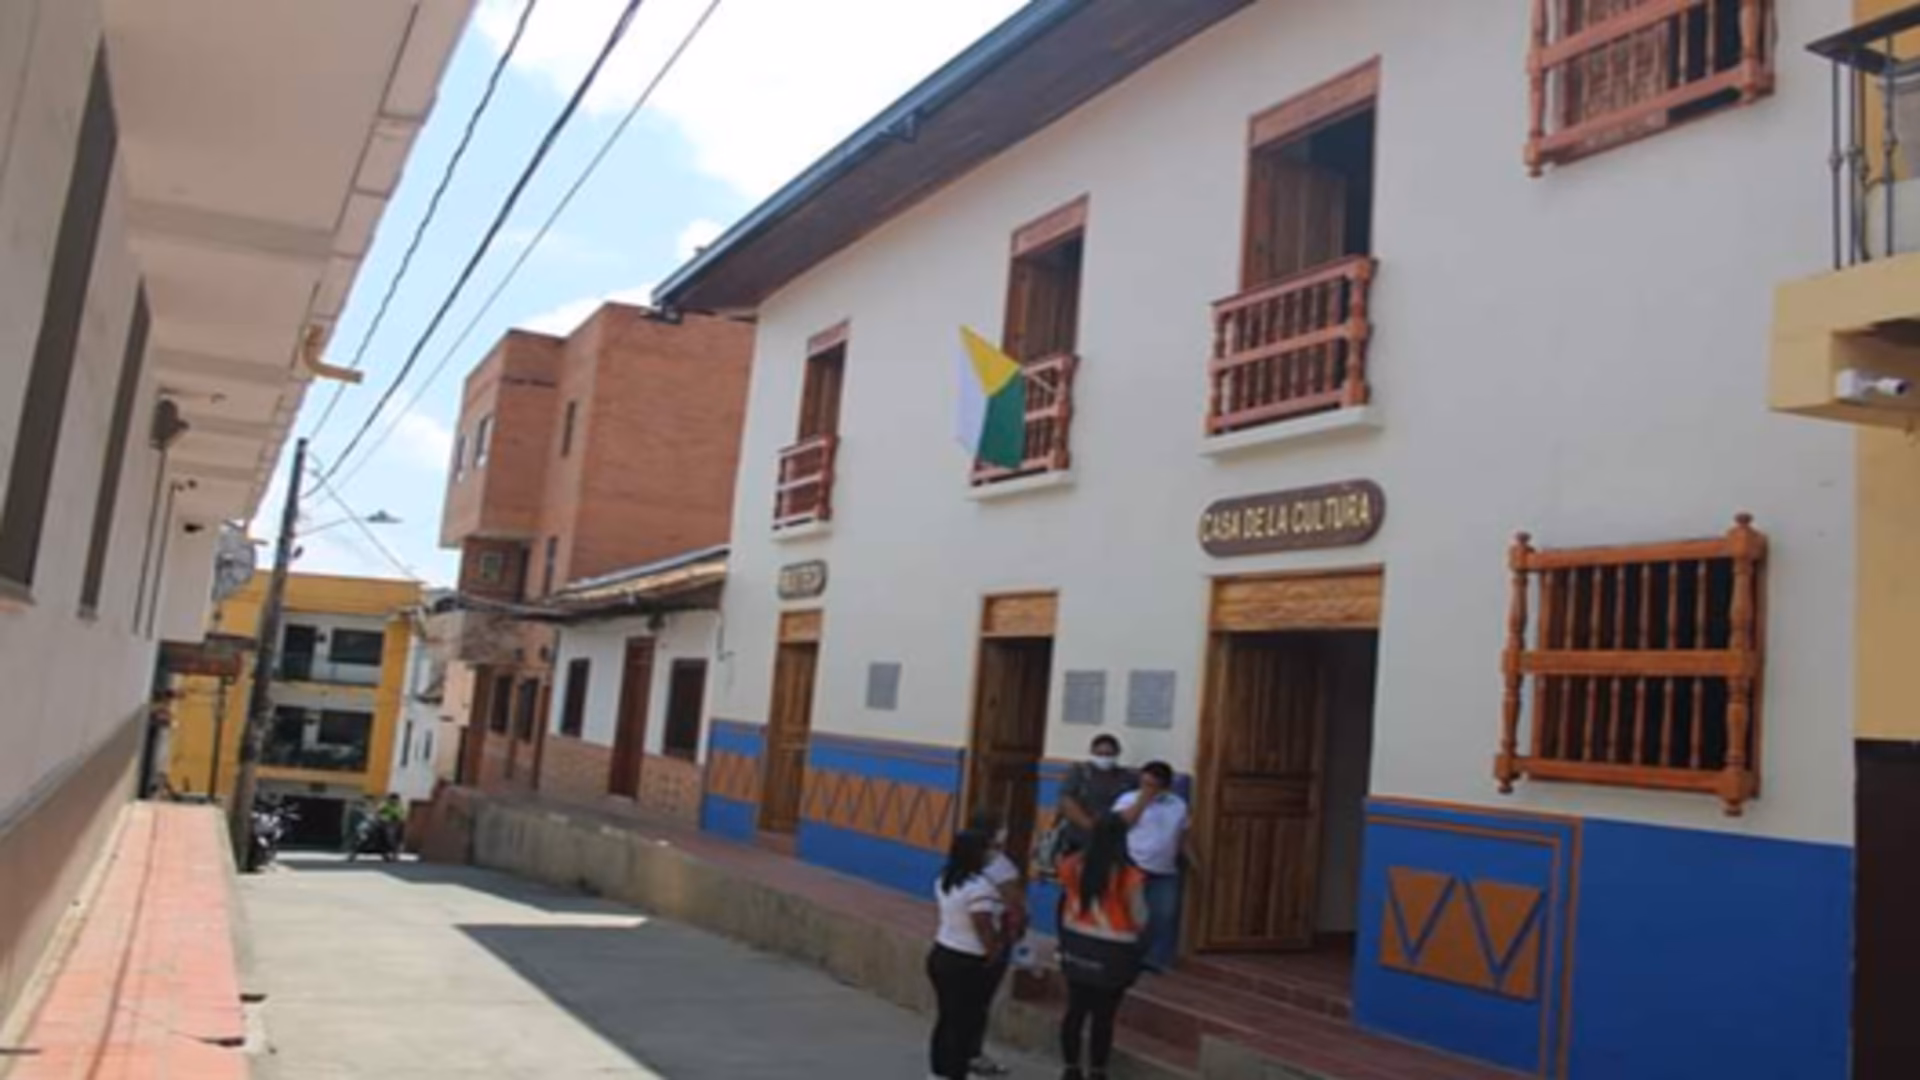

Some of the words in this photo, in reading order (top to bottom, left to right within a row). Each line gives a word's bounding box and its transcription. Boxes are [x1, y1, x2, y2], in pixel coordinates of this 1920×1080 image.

[1201, 511, 1241, 542] CASA
[1243, 506, 1267, 539] DE
[1267, 504, 1288, 536] LA
[1290, 492, 1371, 533] CULTURA
